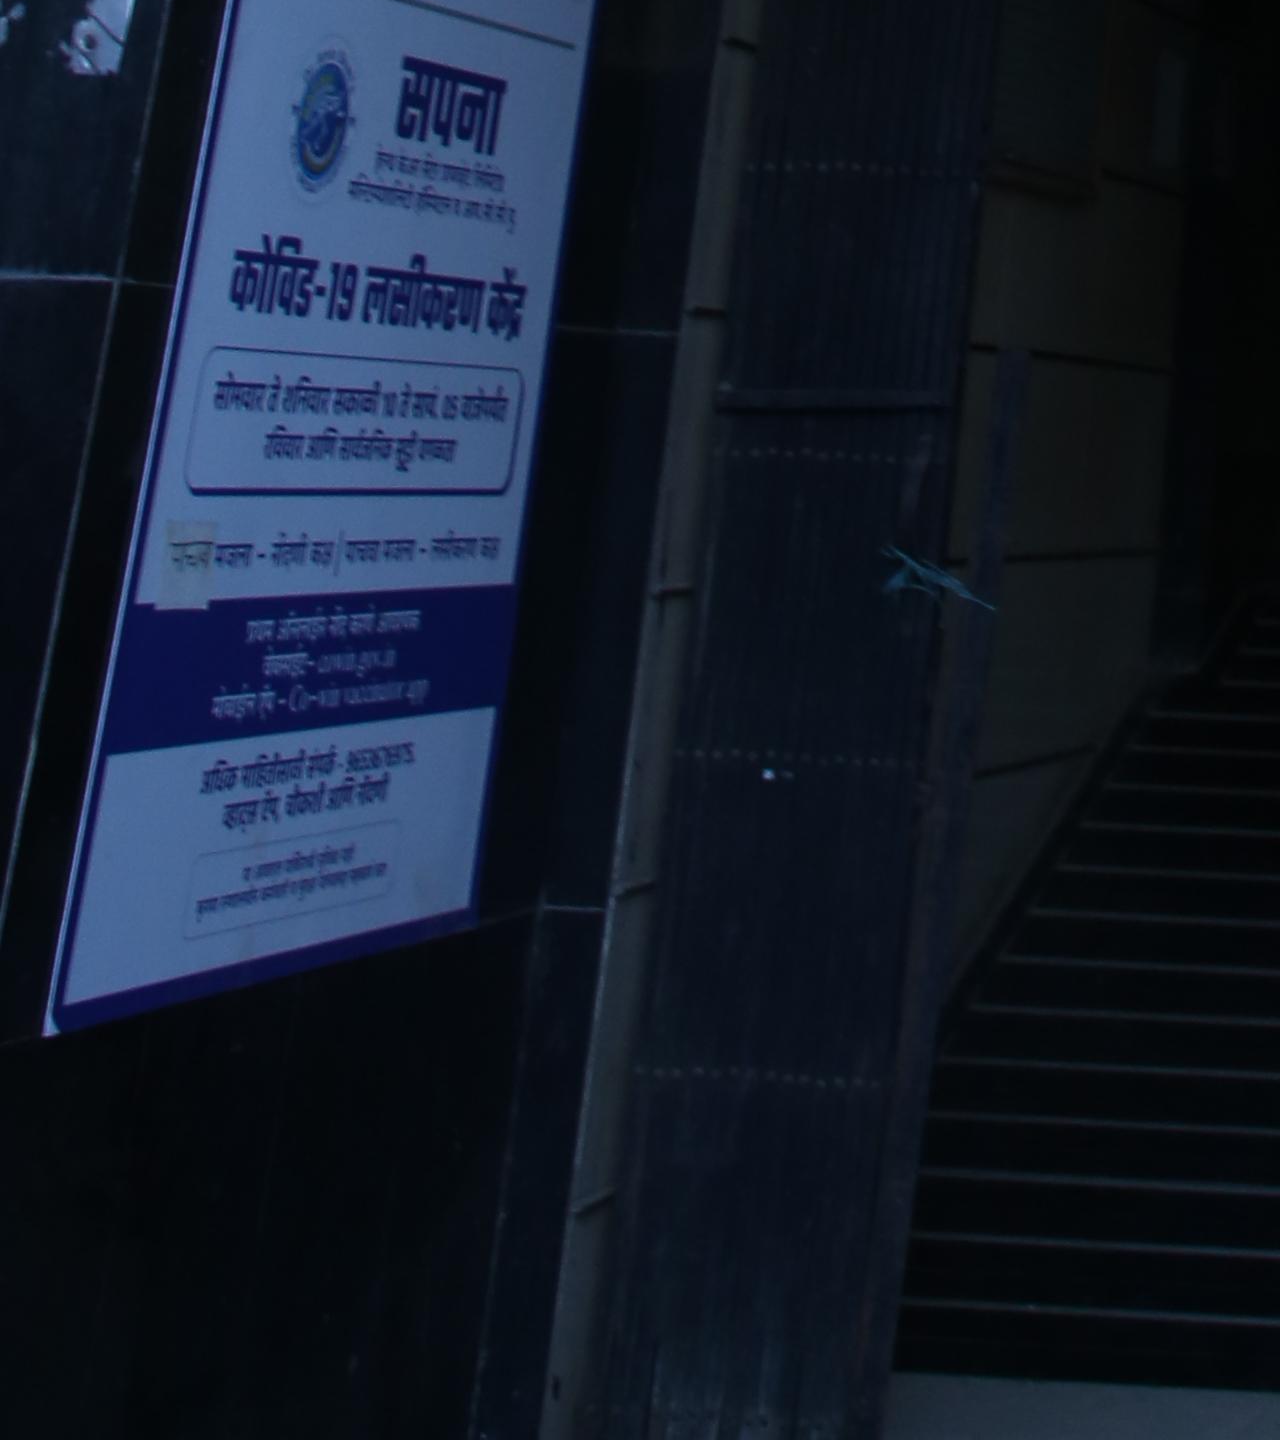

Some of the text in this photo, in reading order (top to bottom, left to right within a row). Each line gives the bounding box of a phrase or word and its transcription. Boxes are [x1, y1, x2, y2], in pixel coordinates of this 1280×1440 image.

[396, 56, 507, 156] सपना
[229, 234, 358, 321] कोविड-19
[361, 253, 486, 333] लसीकरण
[214, 371, 267, 410] सोमवार
